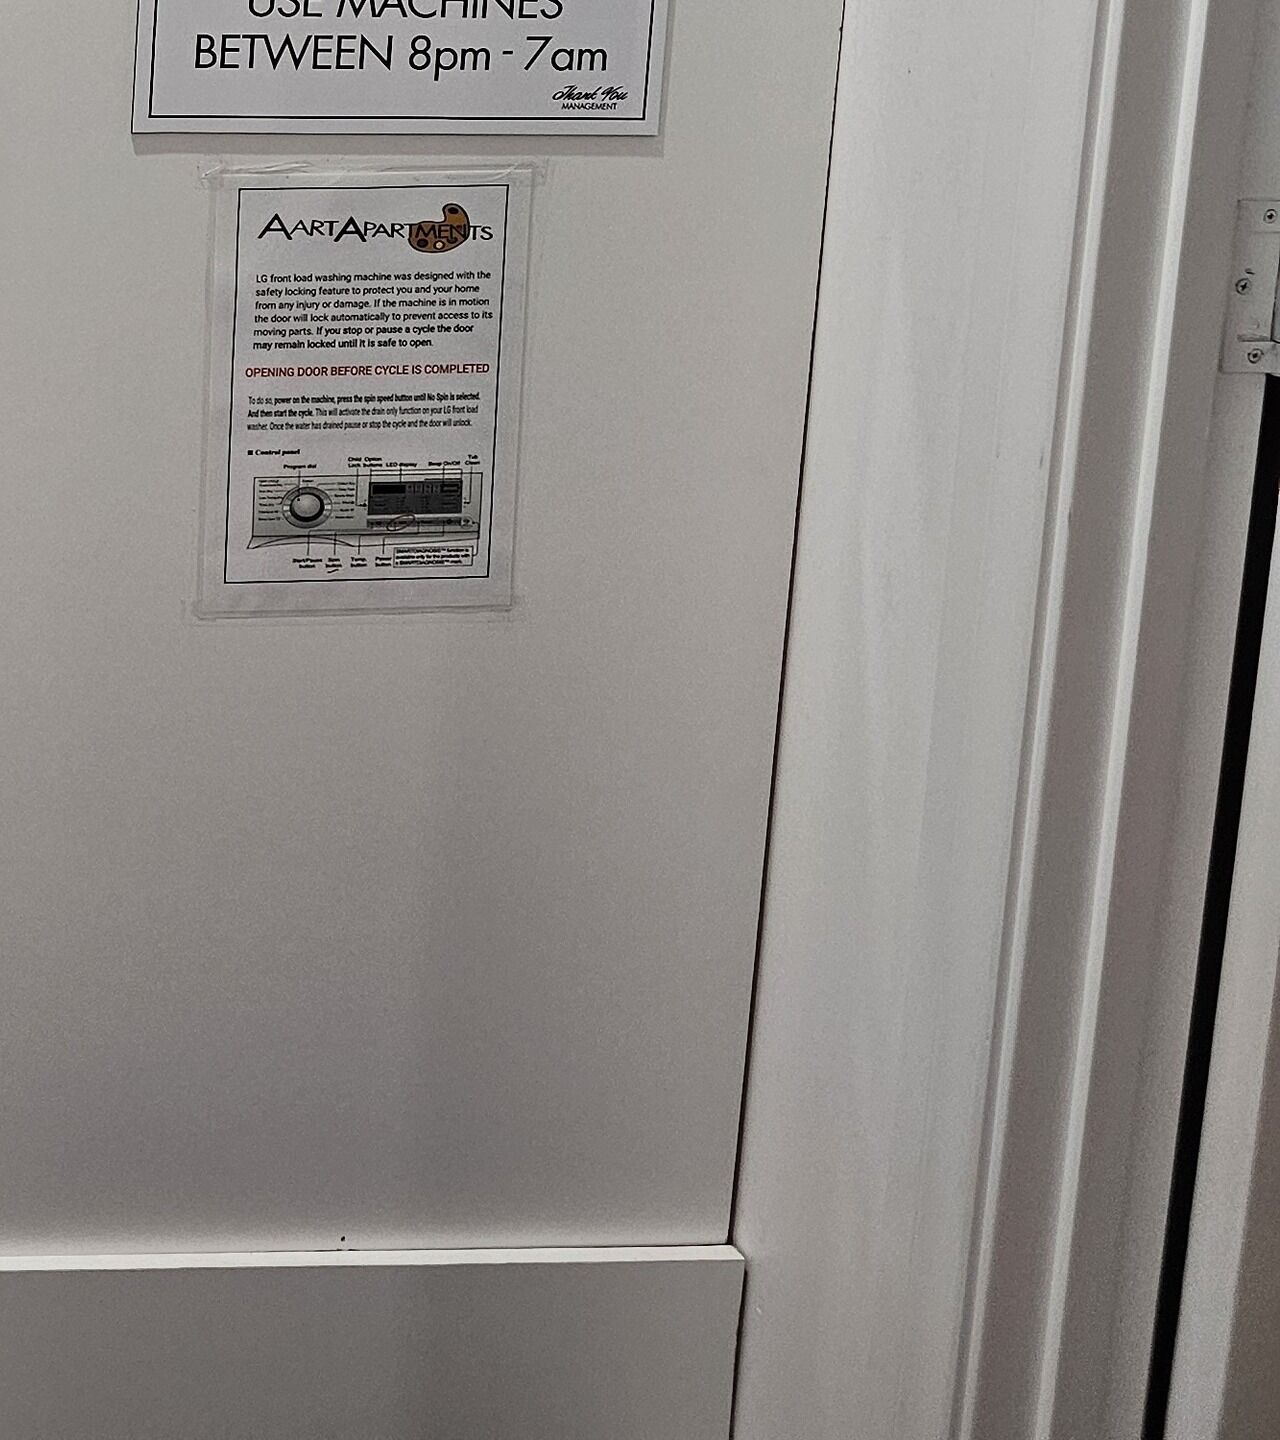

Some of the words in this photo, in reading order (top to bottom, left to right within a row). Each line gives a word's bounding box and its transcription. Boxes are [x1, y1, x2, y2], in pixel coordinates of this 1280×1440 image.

[194, 34, 393, 70] BETWEEN
[409, 35, 490, 81] 8pm
[523, 35, 607, 72] 7am
[552, 85, 602, 100] Thank
[601, 86, 628, 101] You
[561, 102, 617, 110] MANAGEMENT
[256, 275, 268, 283] LG
[270, 274, 292, 283] front
[293, 273, 313, 282] load
[315, 273, 352, 284] washing
[353, 272, 391, 281] machine
[394, 273, 412, 281] was
[414, 271, 454, 282] designed
[456, 271, 475, 280] with
[477, 271, 491, 279] the
[255, 287, 283, 299] safety
[285, 287, 317, 297] locking
[318, 286, 350, 296] feature
[352, 287, 361, 295] to
[362, 285, 394, 297] protect
[396, 287, 412, 296] you
[414, 285, 431, 294] and
[433, 286, 453, 295] your
[454, 284, 480, 293] home
[245, 367, 295, 378] OPENING
[297, 367, 328, 377] DOOR
[331, 366, 372, 376] BEFORE
[374, 365, 409, 375] CYCLE
[411, 364, 422, 374] IS
[424, 364, 490, 374] COMPLETED
